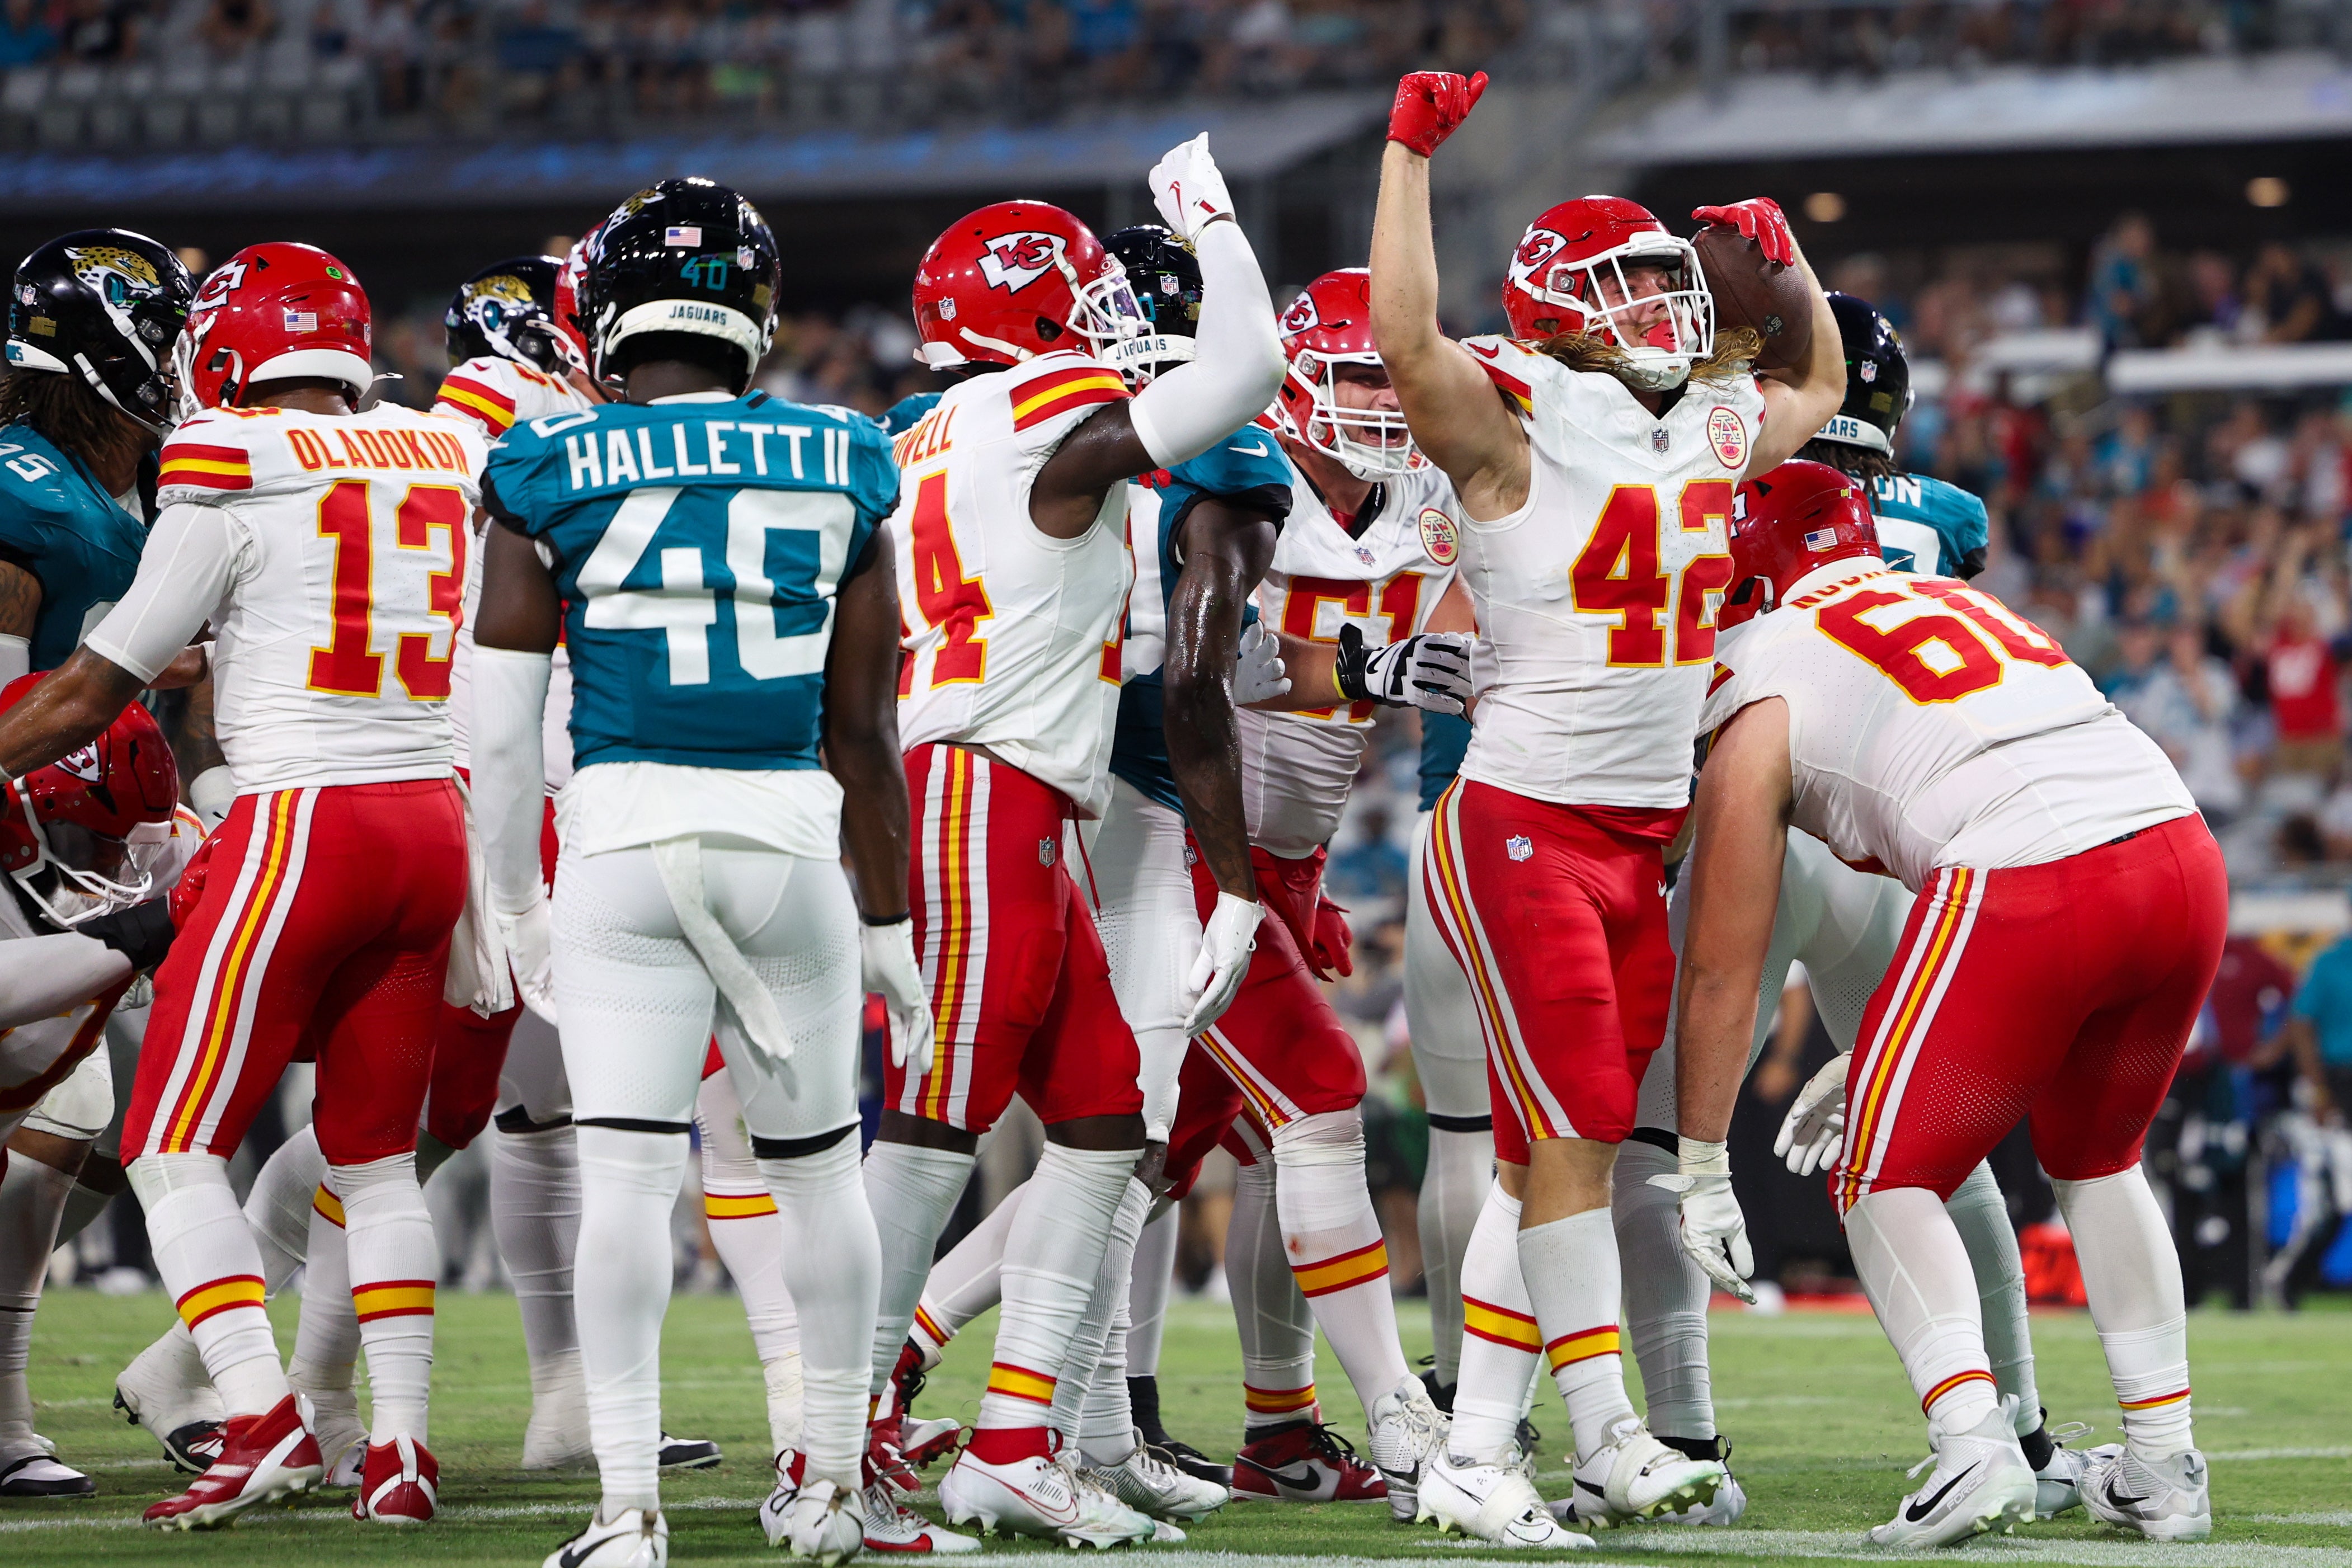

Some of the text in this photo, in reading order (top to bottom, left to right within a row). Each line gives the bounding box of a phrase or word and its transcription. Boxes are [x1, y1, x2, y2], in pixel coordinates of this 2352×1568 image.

[994, 235, 1054, 271] KC
[680, 256, 727, 291] 40
[1164, 283, 1177, 291] NFL
[669, 305, 727, 326] JAGUARS
[285, 428, 471, 478] OLADOKUN
[565, 421, 850, 491] HALLETT II
[892, 404, 959, 470] OWELL
[1655, 439, 1667, 450] NFL
[1850, 474, 1921, 508] ON
[305, 478, 468, 701] 13
[576, 486, 856, 686] 40
[896, 468, 995, 699] 4
[1568, 478, 1735, 668] 42
[1814, 580, 2073, 707] 60
[1042, 850, 1054, 860] NFL
[1512, 846, 1528, 856] NFL
[1947, 1473, 1986, 1511] FORCE
